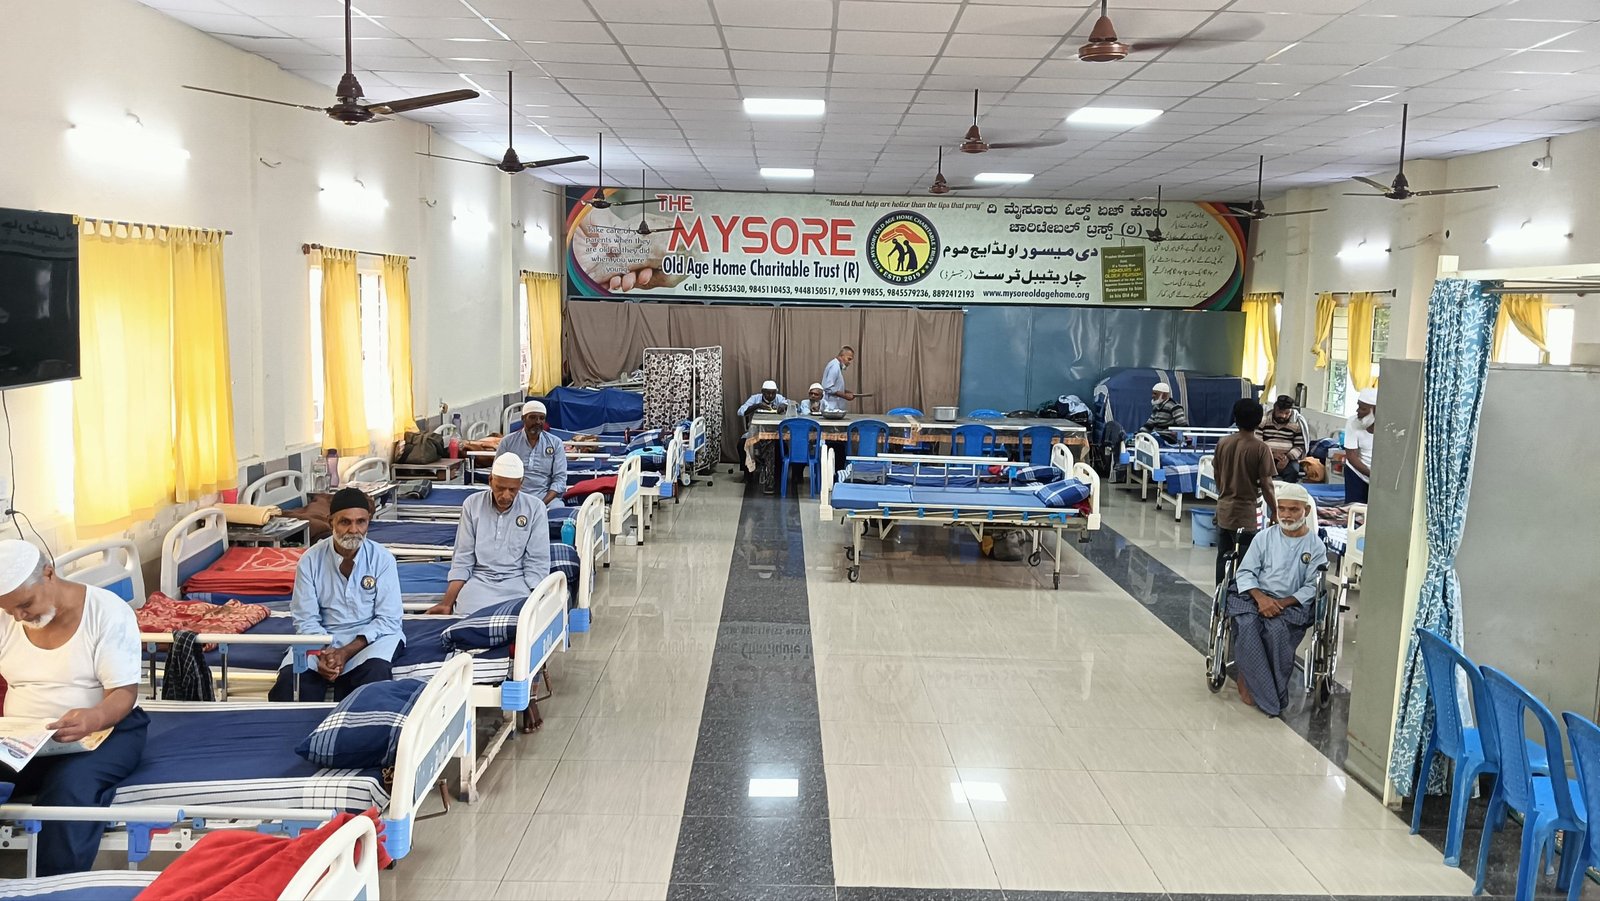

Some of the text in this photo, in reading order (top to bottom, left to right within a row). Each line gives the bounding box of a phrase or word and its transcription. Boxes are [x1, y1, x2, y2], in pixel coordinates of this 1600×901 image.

[656, 195, 694, 212] THE
[866, 200, 878, 209] help
[938, 202, 950, 210] lips
[986, 203, 997, 215] ದಿ
[1004, 202, 1058, 220] ಮೈಸೂರು
[875, 223, 886, 234] OLD
[885, 216, 896, 225] AGE
[1086, 223, 1114, 240] ಟ್ರಸ್ಟ್
[667, 214, 856, 257] MYSORE
[662, 256, 860, 283] Old Age Home Charitable Trust (R)
[882, 271, 921, 282] ESTD 2019
[684, 283, 697, 292] Cell
[703, 284, 748, 294] 9535653430,
[748, 285, 793, 295] 9845110453,
[794, 286, 838, 296] 9448150517,
[839, 287, 861, 296] 91699
[886, 288, 931, 299] 9845579236,
[932, 289, 975, 299] 8892412193
[982, 289, 1090, 301] www.mysoreoldagehome.org
